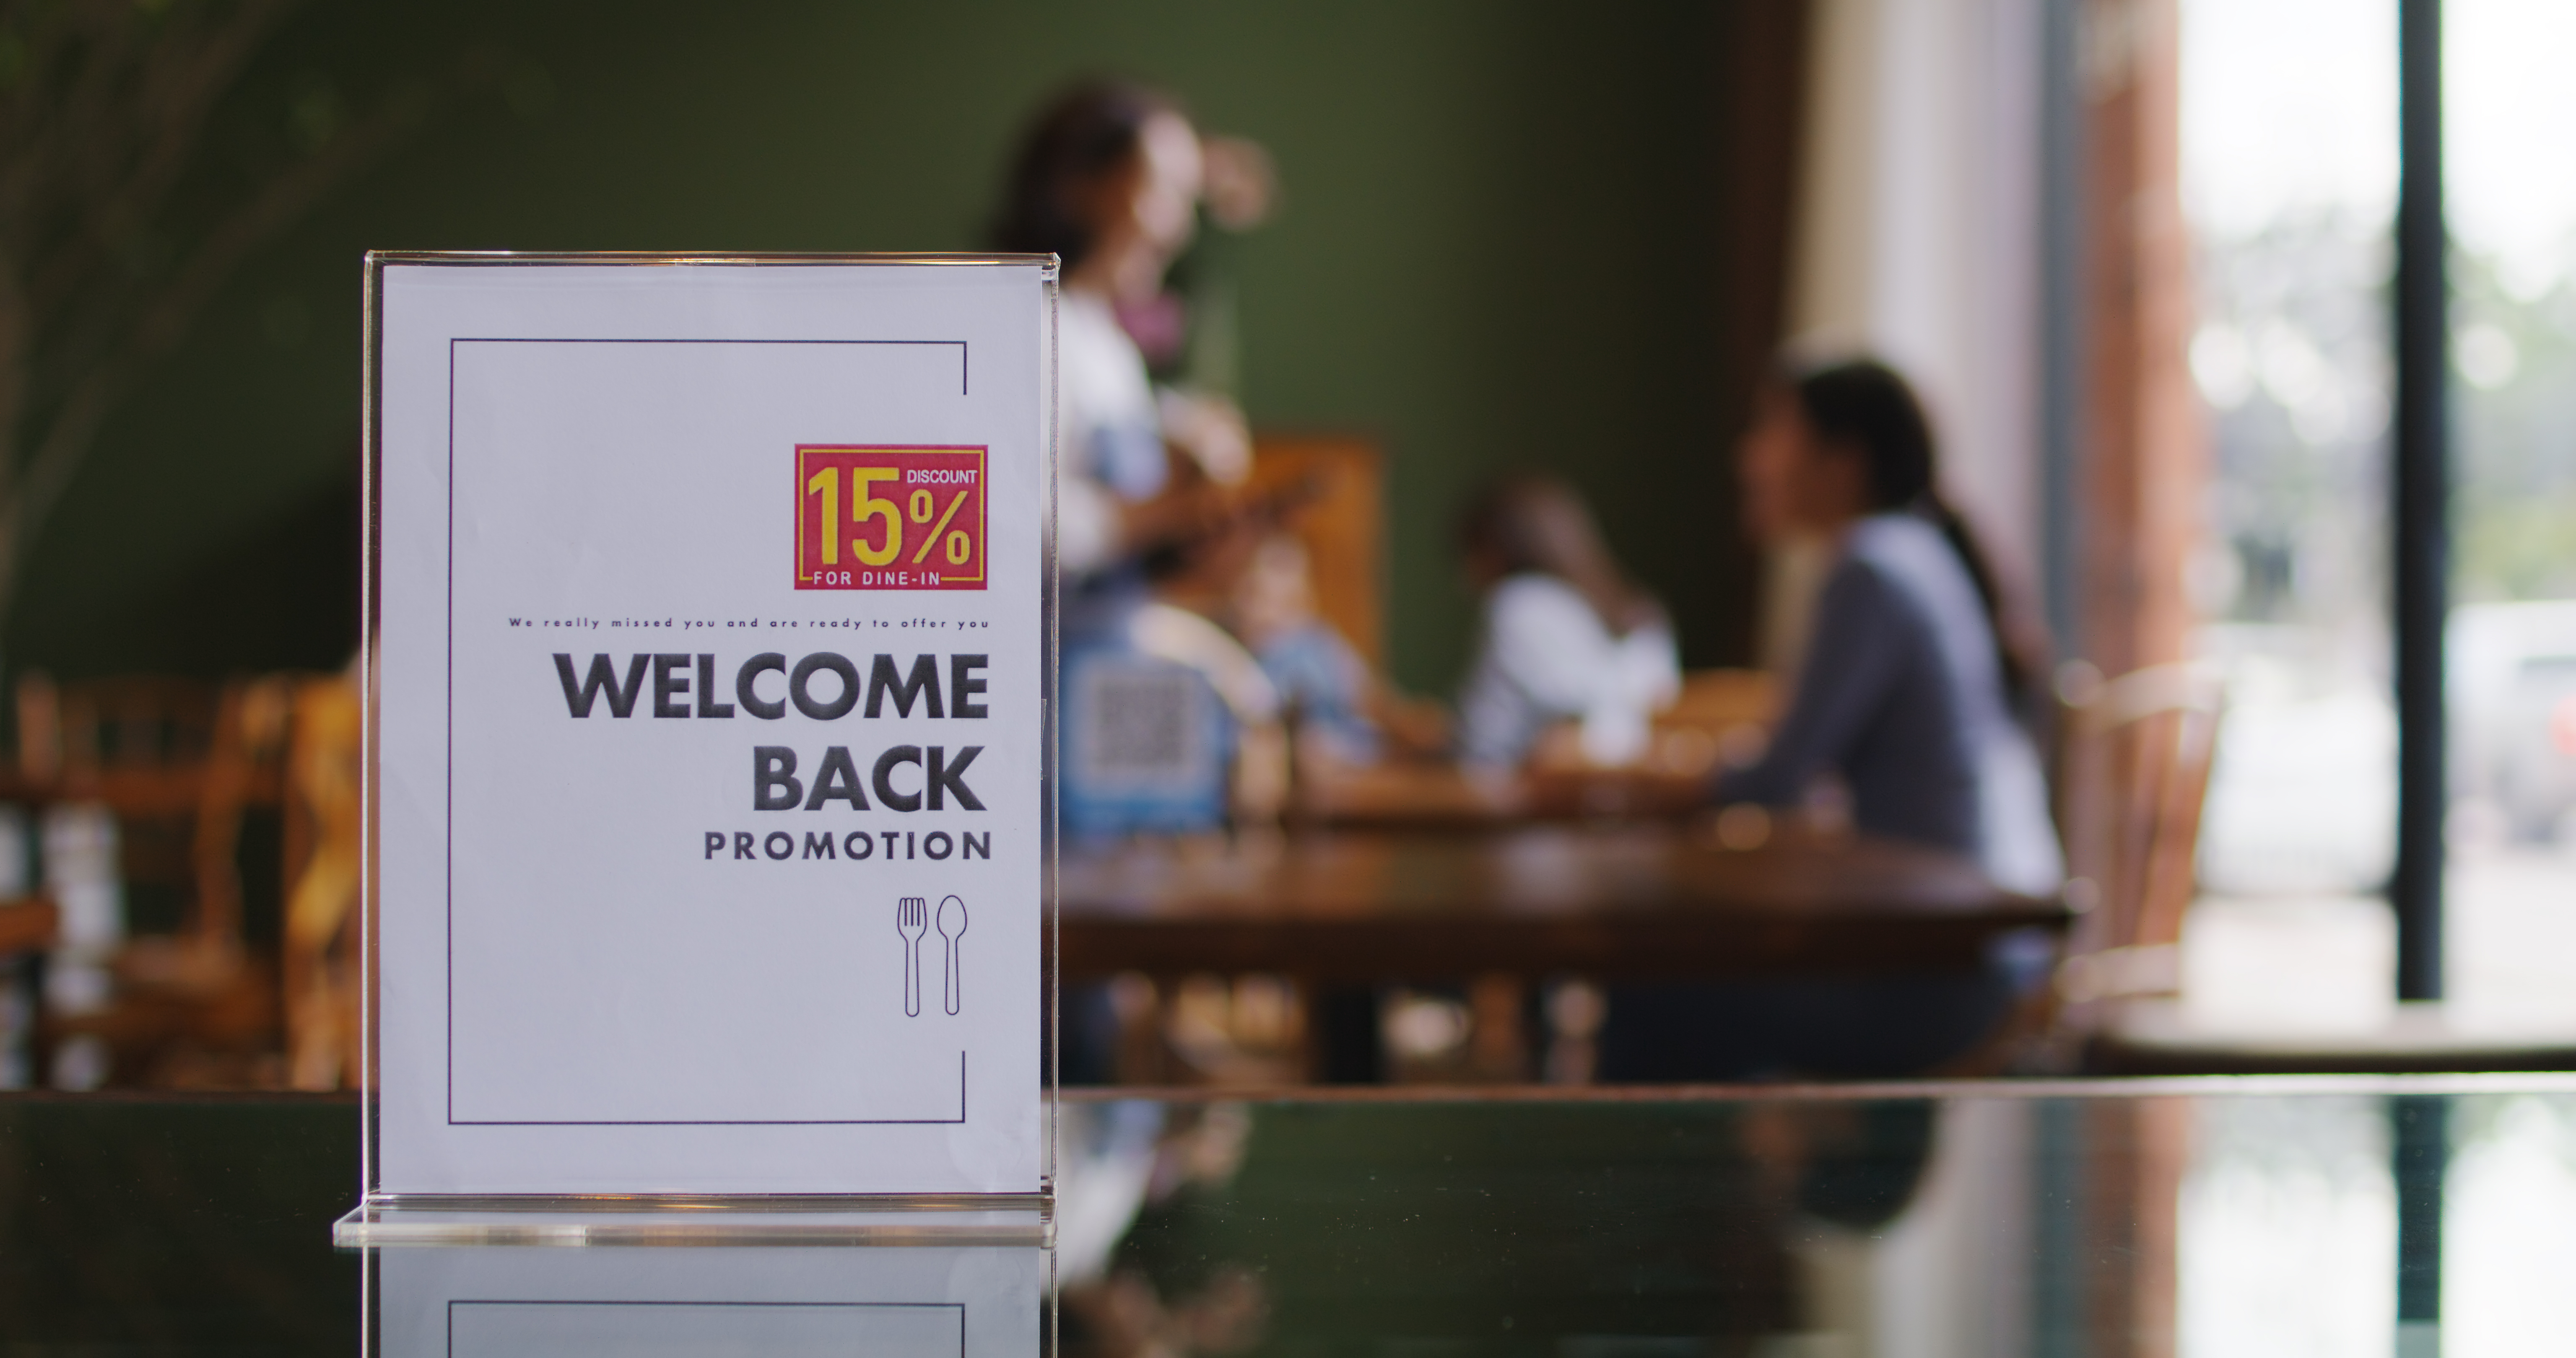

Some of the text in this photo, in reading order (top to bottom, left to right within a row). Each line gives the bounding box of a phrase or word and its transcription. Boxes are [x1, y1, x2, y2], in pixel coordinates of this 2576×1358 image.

[906, 469, 978, 484] DISCOUNT
[808, 466, 971, 566] 15%
[813, 571, 940, 585] FOR DINE-IN
[509, 617, 532, 627] We
[544, 617, 599, 630] really
[611, 617, 672, 627] missed
[684, 620, 715, 630] you
[727, 617, 758, 628] and
[810, 617, 861, 630] ready
[873, 619, 889, 628] to
[901, 618, 946, 628] offer
[958, 621, 989, 631] you
[552, 651, 989, 721] WELCOME
[753, 744, 988, 813] BACK
[704, 830, 991, 861] PROMOTION
